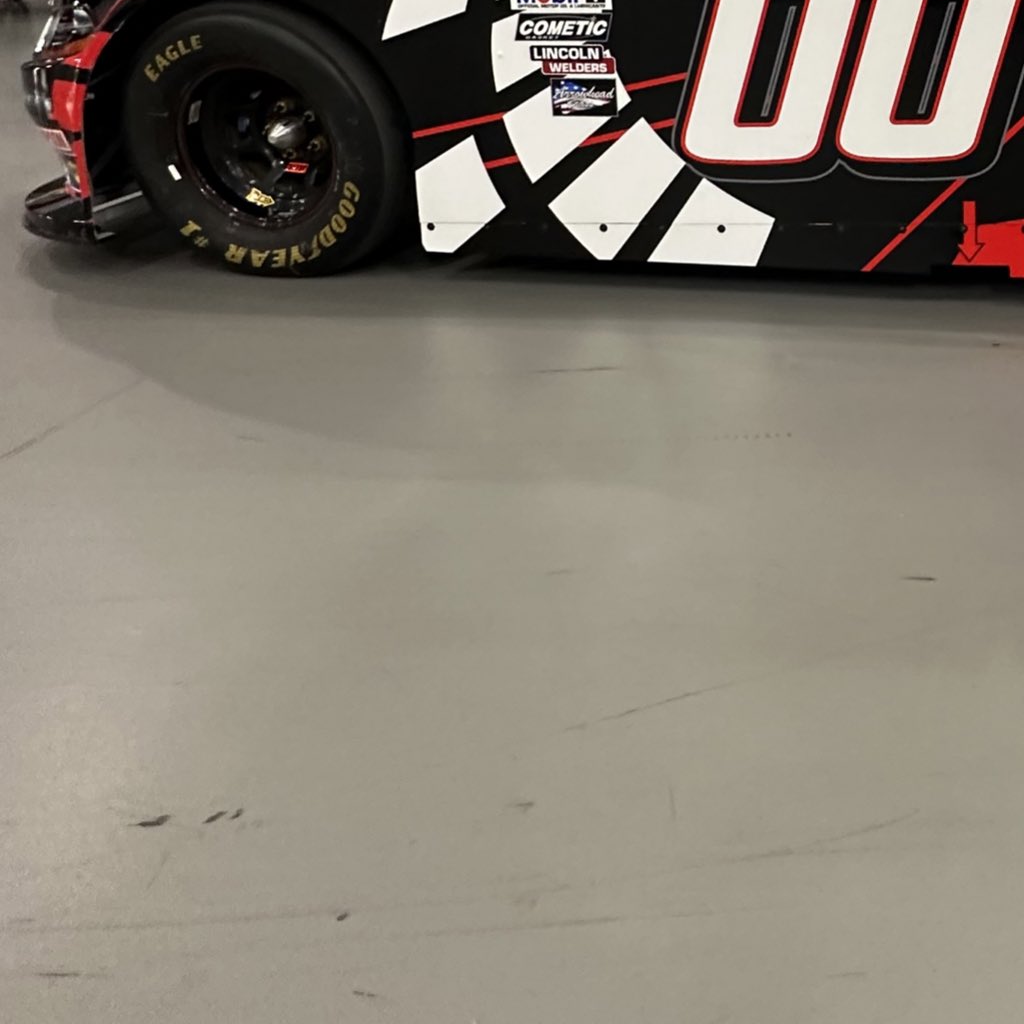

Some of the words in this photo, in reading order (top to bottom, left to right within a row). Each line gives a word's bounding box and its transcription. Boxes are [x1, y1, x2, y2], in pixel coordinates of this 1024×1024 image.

[519, 18, 607, 36] COMETIC
[144, 34, 203, 82] EAGLE
[532, 47, 600, 60] LINCOLN
[549, 63, 608, 73] WELDERS
[224, 181, 361, 268] GOODYEAR
